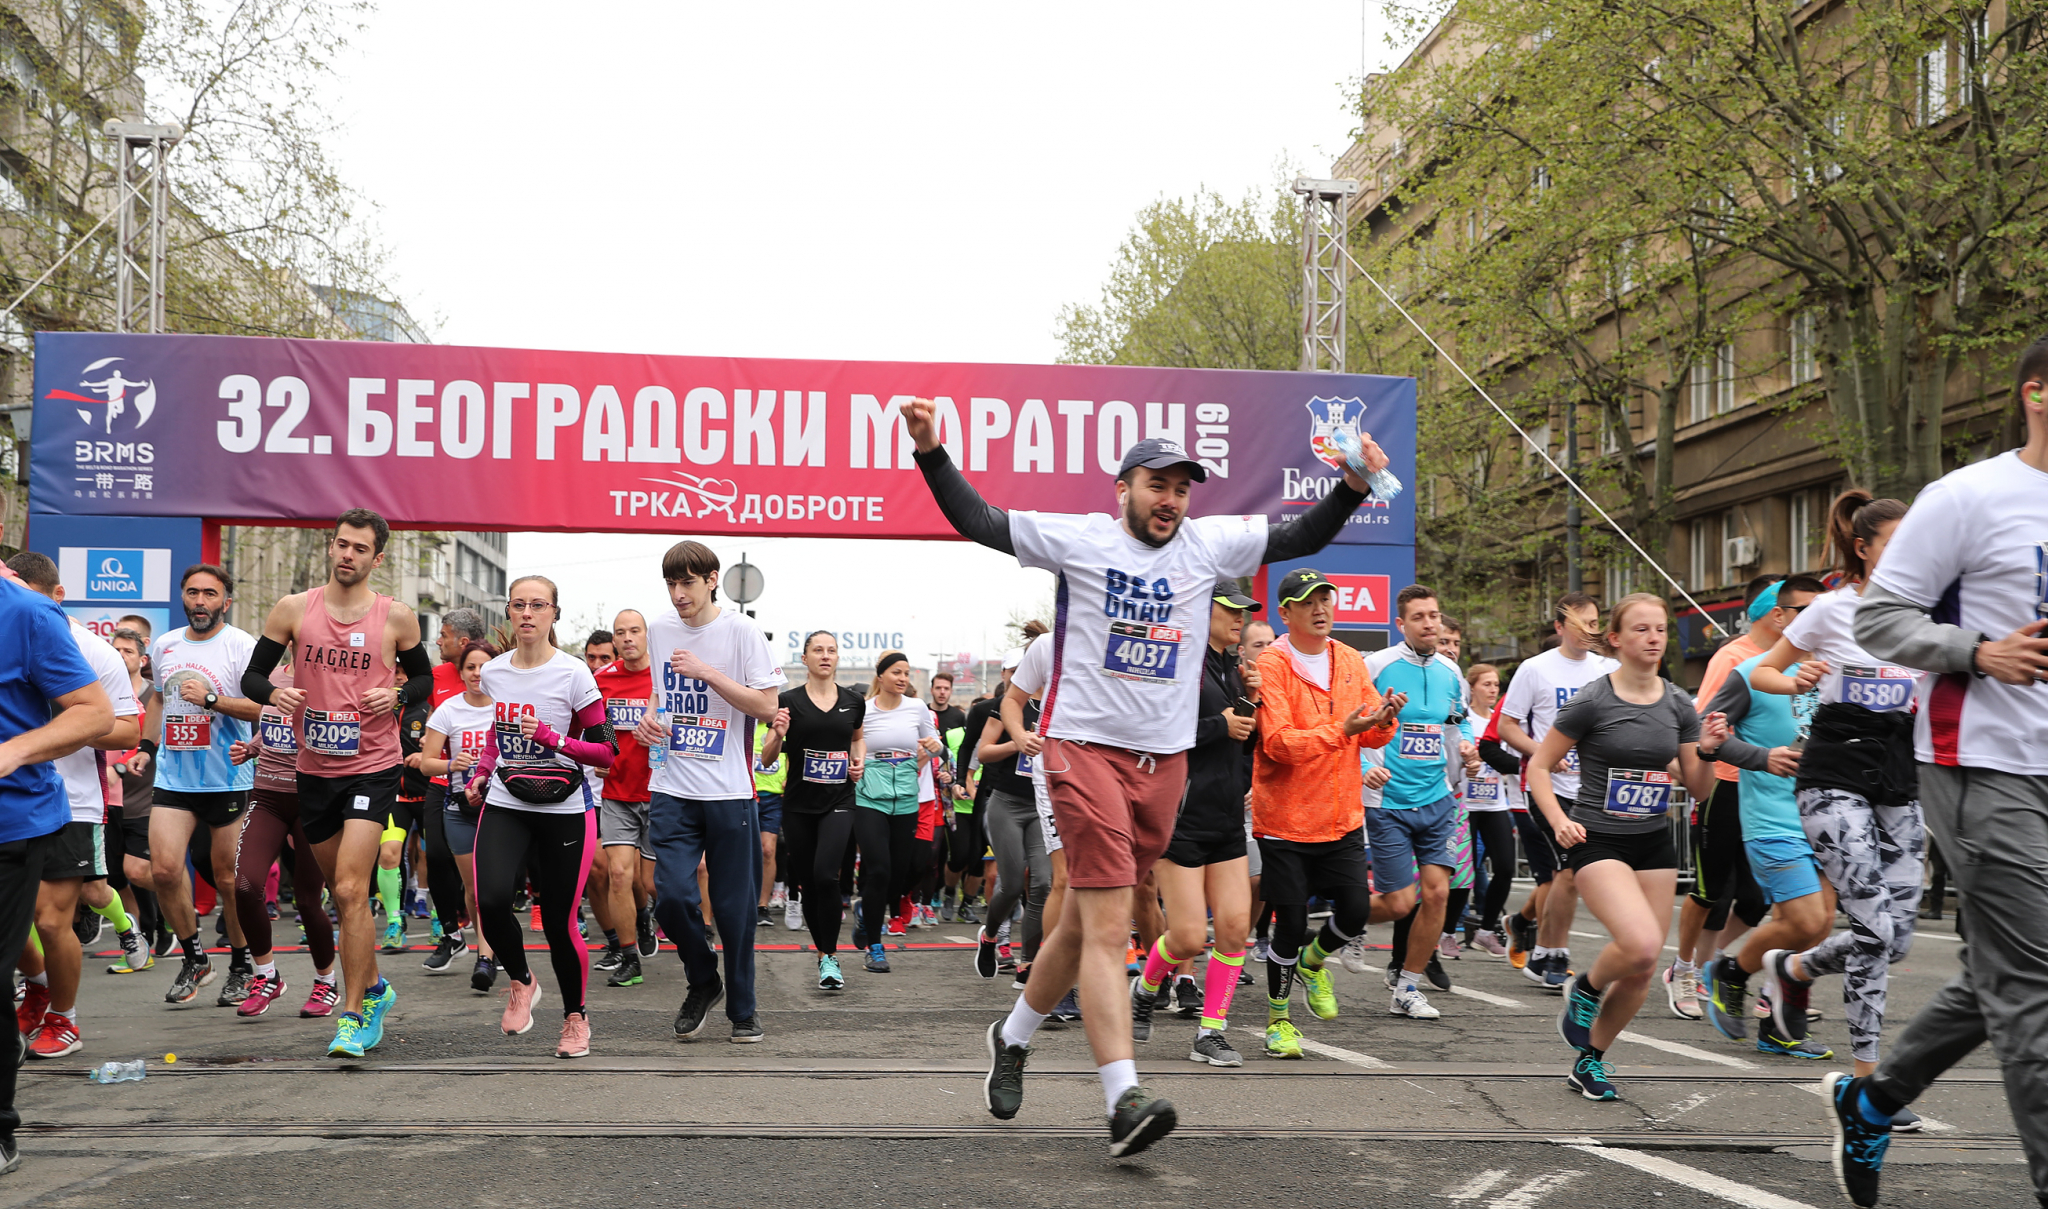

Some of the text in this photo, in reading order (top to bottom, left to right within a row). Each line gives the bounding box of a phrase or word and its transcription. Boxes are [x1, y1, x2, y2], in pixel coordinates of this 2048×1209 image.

[216, 374, 332, 454] 32.
[347, 377, 826, 467] БЕОГРАДСКИ
[1195, 402, 1230, 479] 2019
[75, 440, 155, 464] BRMS
[74, 472, 154, 491] 一带一路
[609, 490, 884, 524] ТРКА ДОБРОТЕ
[90, 580, 138, 592] UNIQA
[1330, 586, 1377, 611] EA
[788, 630, 904, 649] SSUNG
[304, 644, 372, 670] ZAGREB
[1114, 640, 1172, 669] 4037
[665, 692, 709, 714] GRAD
[1847, 682, 1906, 706] 8580
[612, 707, 642, 722] 3018
[172, 725, 198, 741] 355
[308, 723, 352, 743] 6209
[675, 727, 718, 748] 3887
[809, 760, 843, 775] 5457
[1470, 783, 1497, 796] 3895
[1616, 784, 1666, 807] 6787
